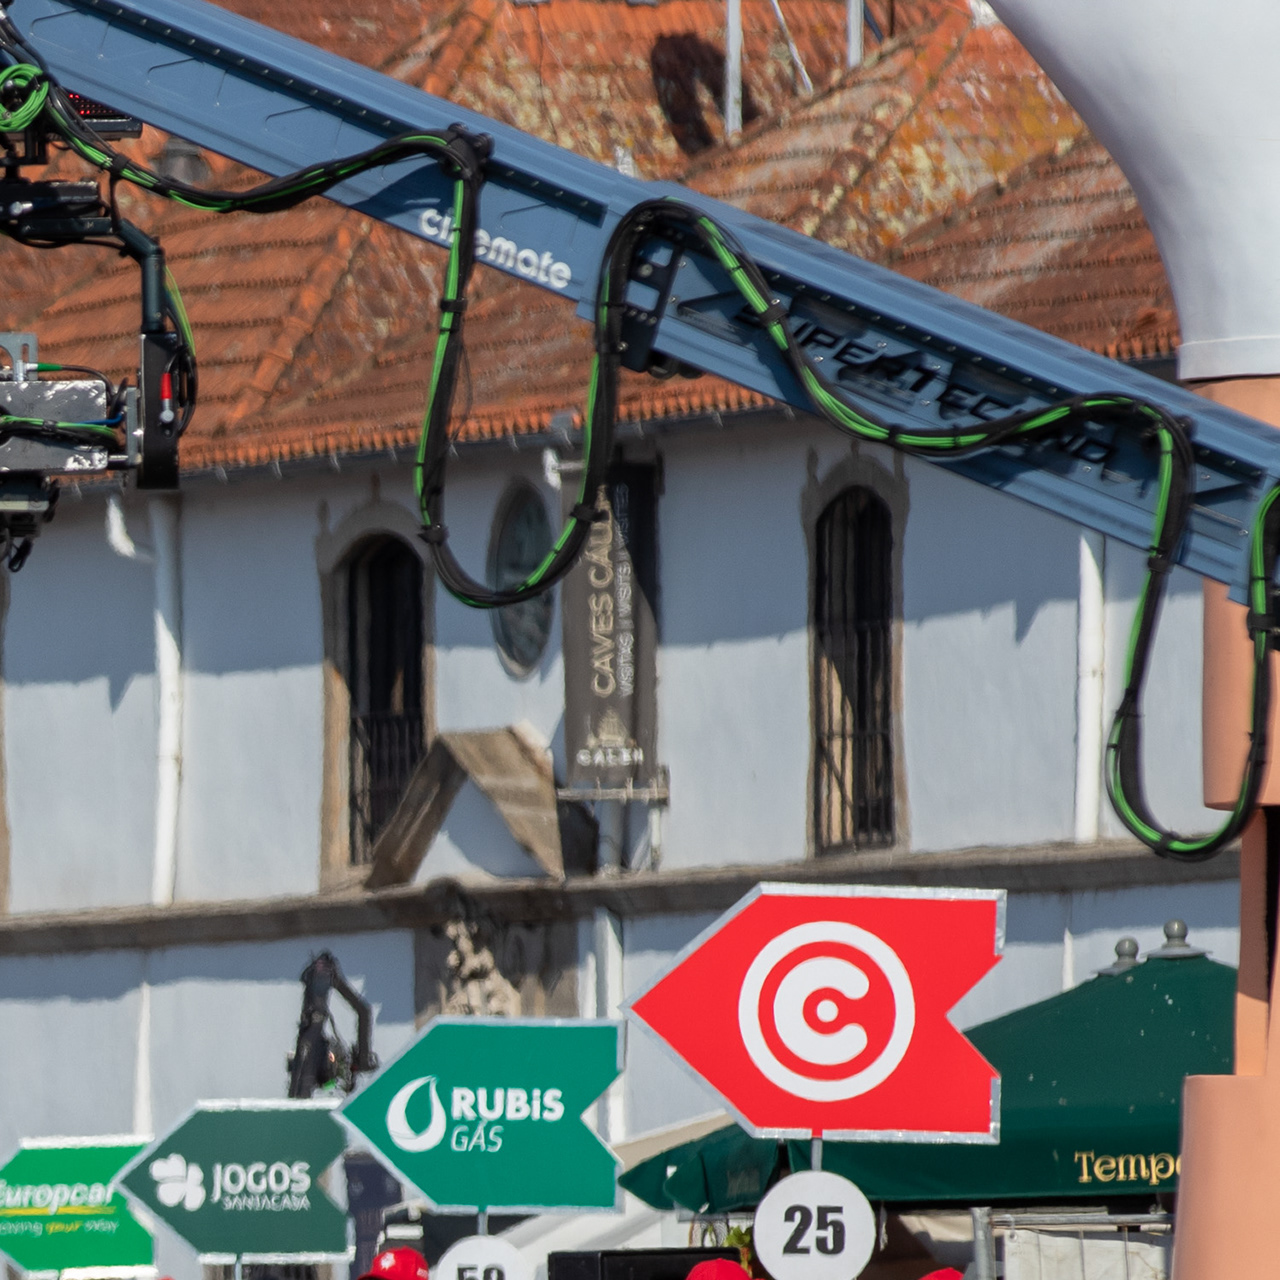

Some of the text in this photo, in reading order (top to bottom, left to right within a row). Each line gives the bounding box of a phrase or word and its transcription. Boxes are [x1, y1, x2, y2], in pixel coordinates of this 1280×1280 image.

[420, 207, 572, 289] ciemate
[588, 593, 616, 699] CAVES
[451, 1119, 504, 1153] GÁS
[211, 1161, 311, 1204] JOGOS
[782, 1204, 847, 1256] 25
